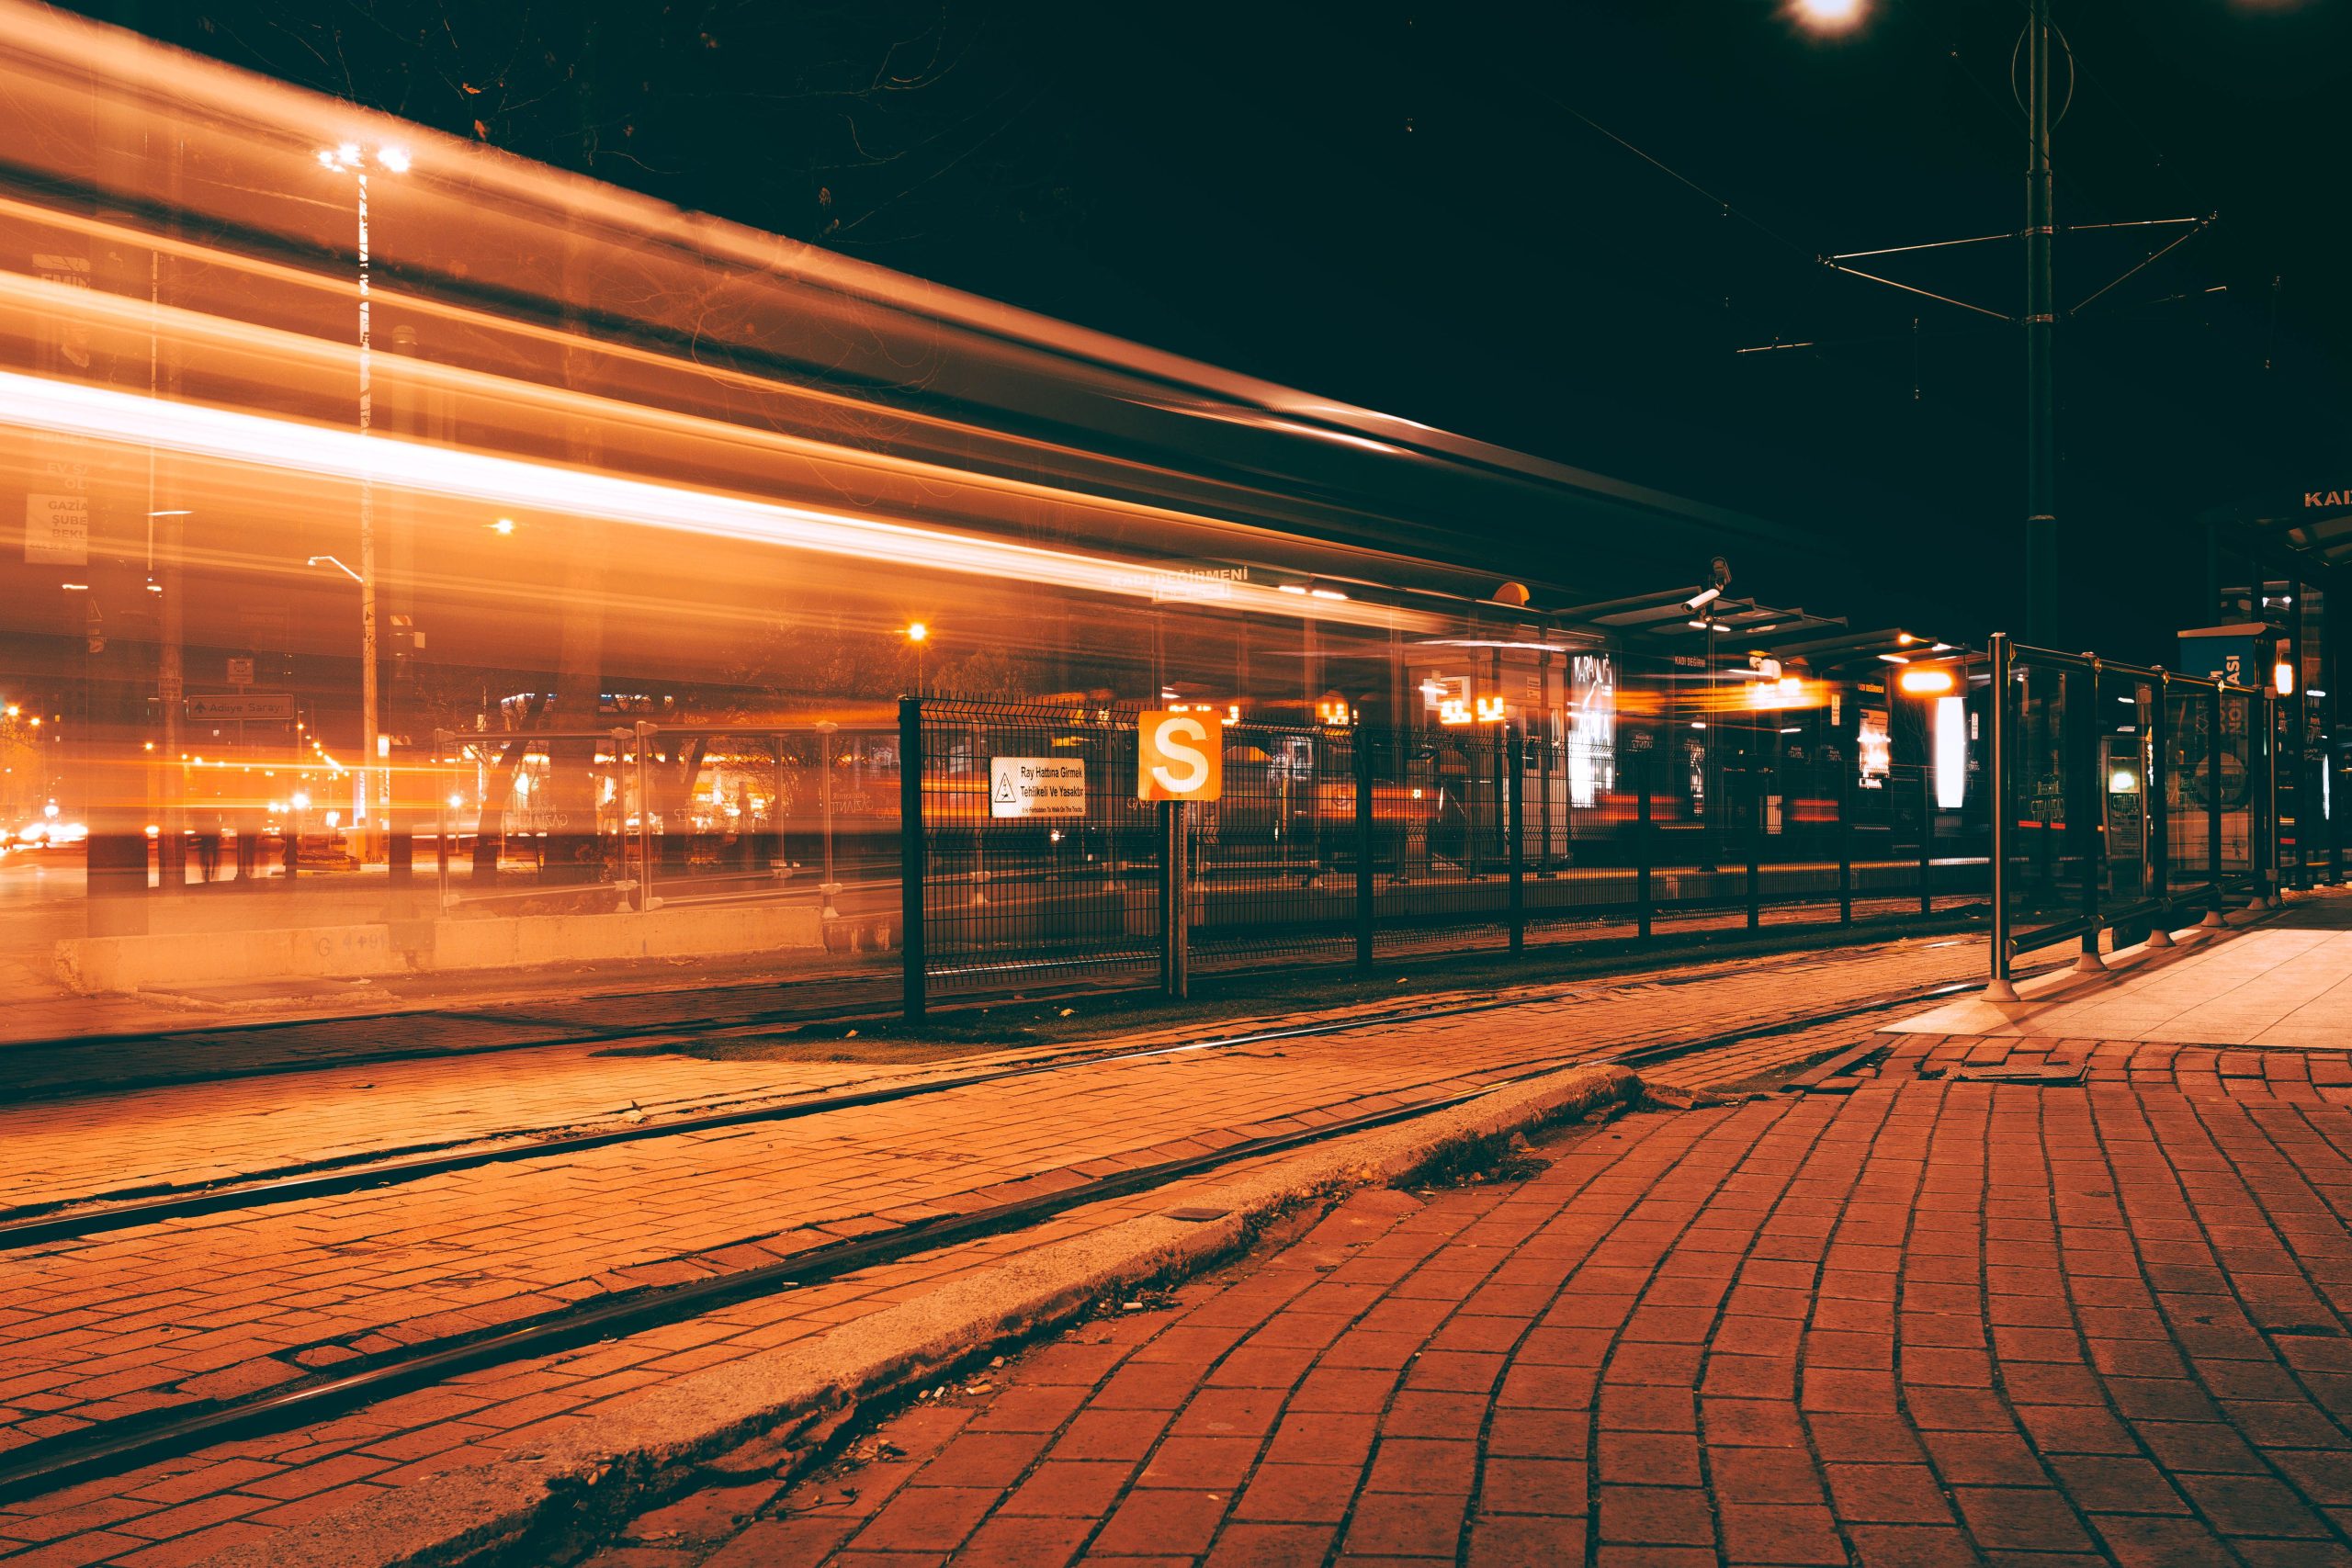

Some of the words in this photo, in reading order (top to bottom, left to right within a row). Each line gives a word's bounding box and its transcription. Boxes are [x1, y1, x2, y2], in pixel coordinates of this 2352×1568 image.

[1152, 717, 1209, 793] S
[1021, 766, 1035, 781] Ray
[1060, 767, 1082, 778] Girmek
[1049, 785, 1057, 797] Ve
